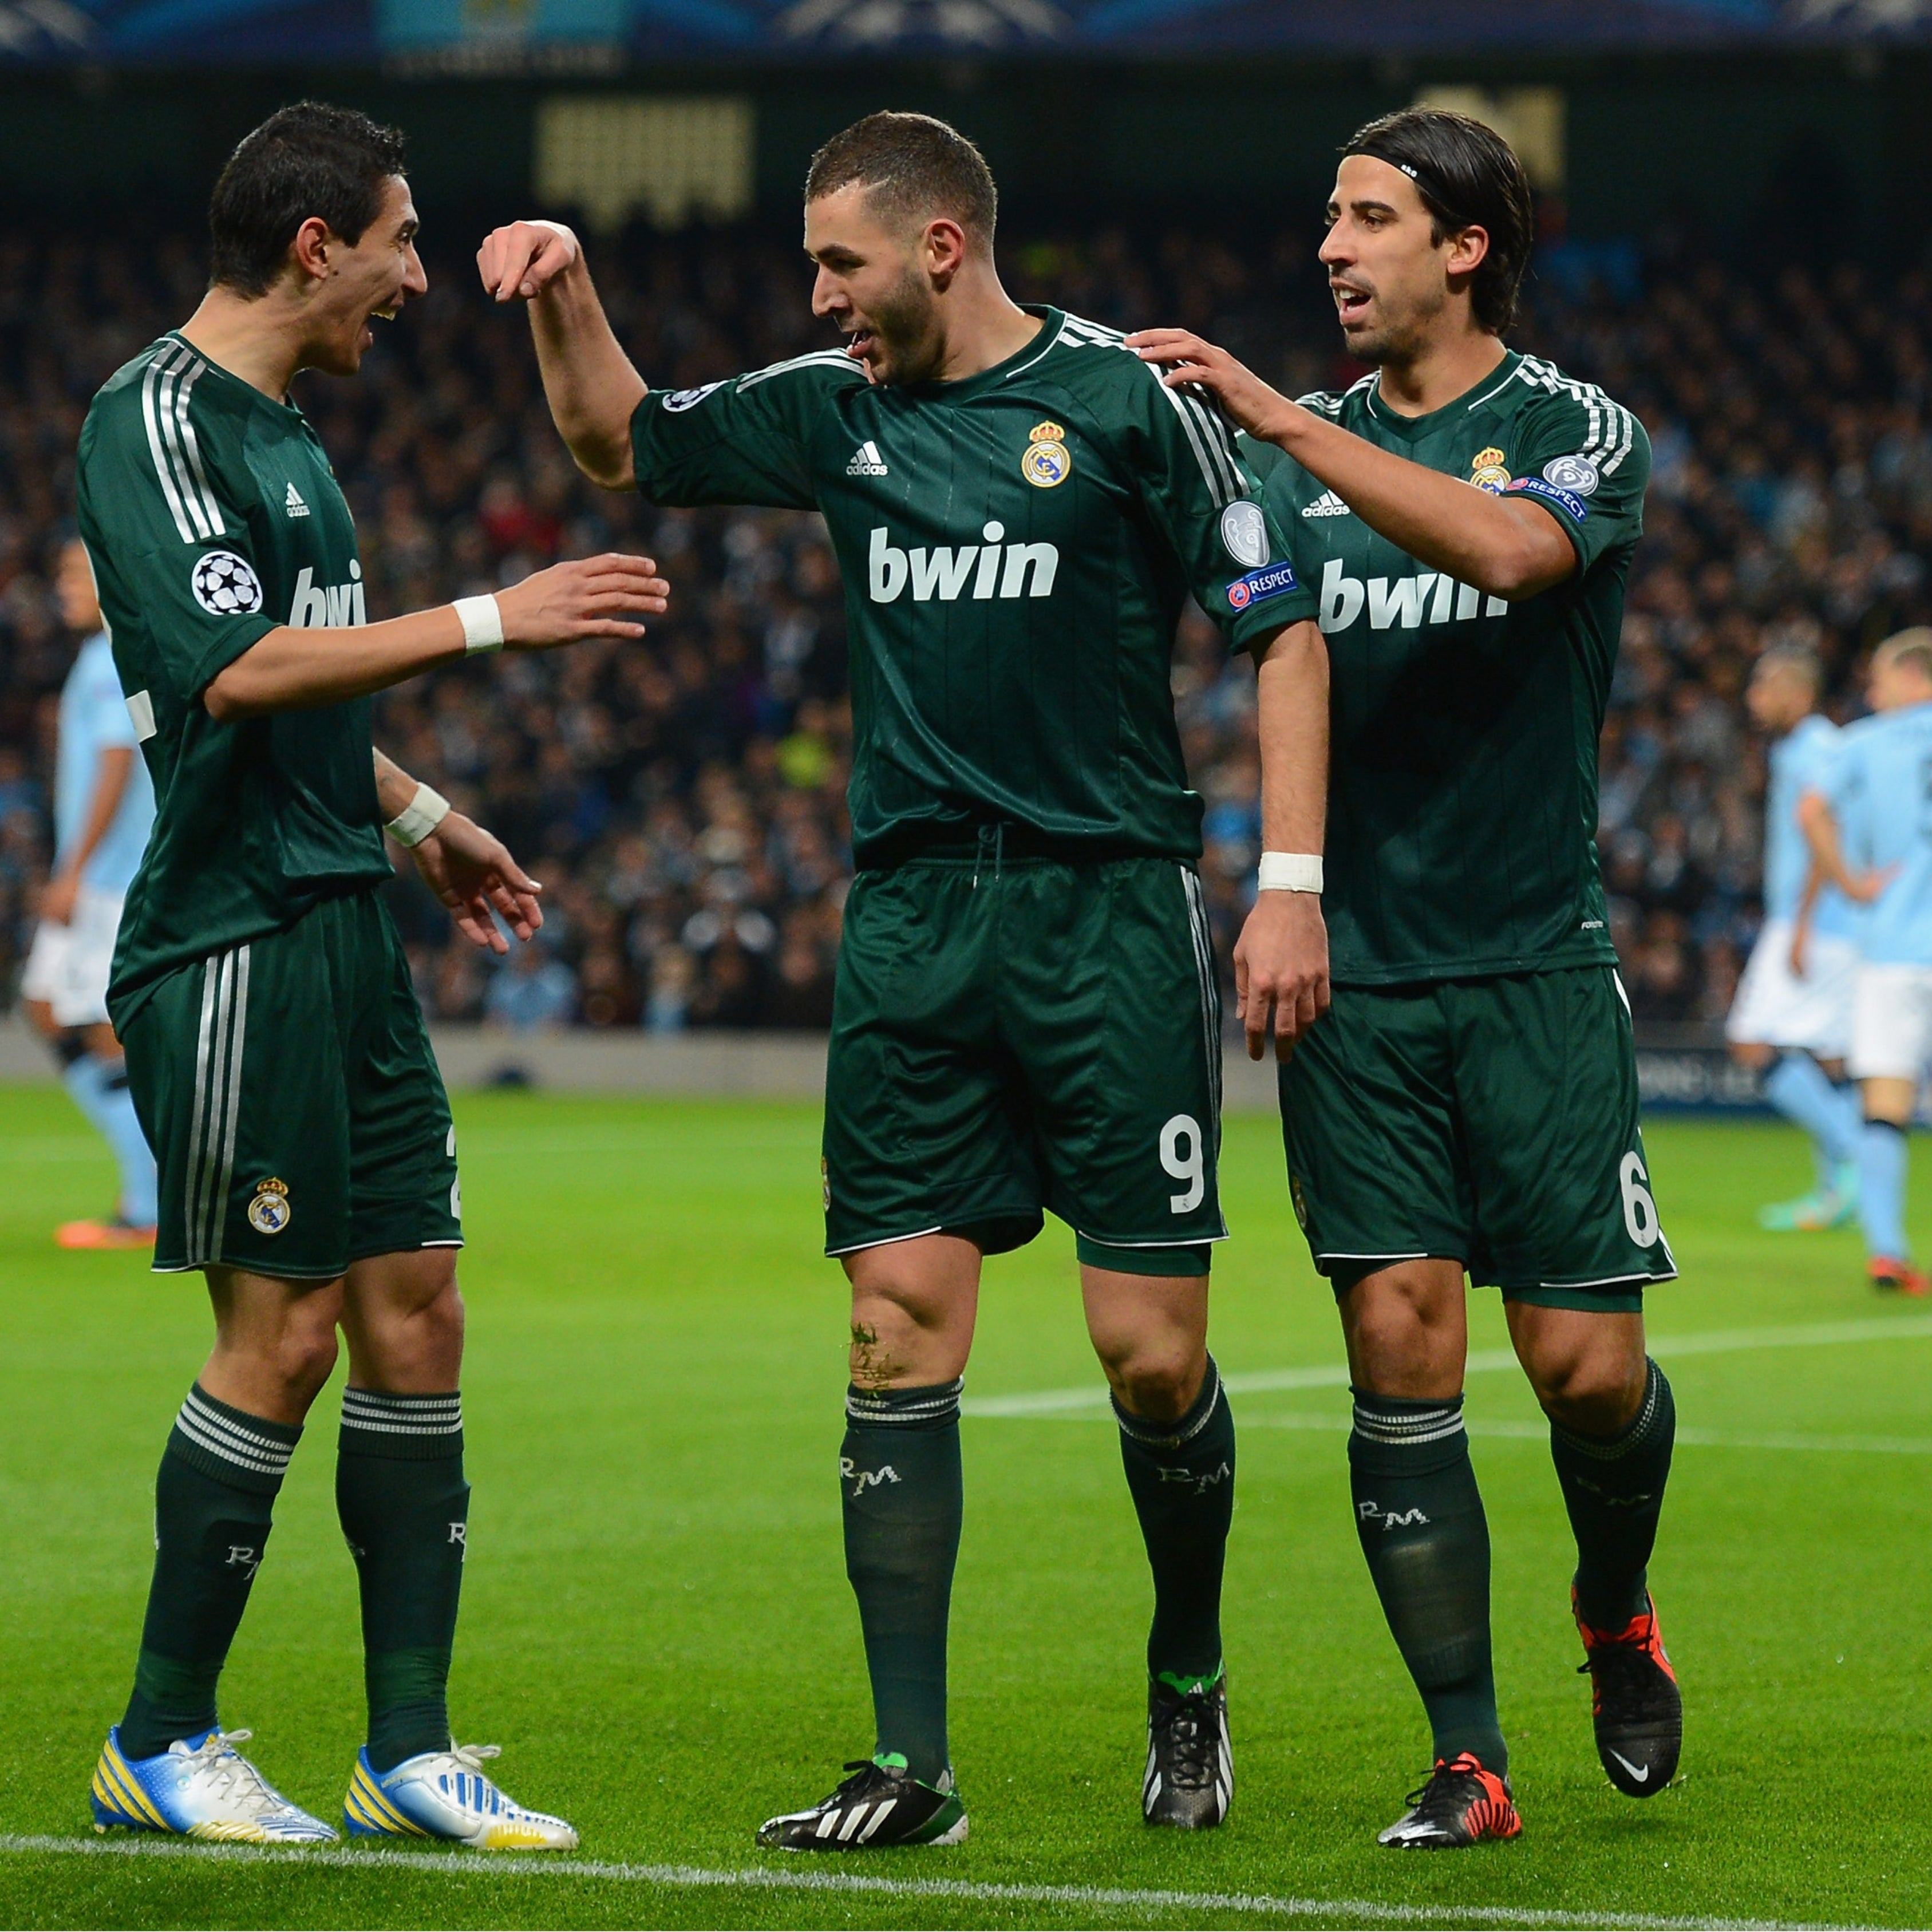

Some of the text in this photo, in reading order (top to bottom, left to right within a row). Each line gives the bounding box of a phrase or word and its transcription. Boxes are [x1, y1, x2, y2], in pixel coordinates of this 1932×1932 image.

[846, 463, 888, 476] adidas
[1302, 504, 1350, 517] adidas
[1528, 481, 1585, 517] RESPECT
[869, 520, 1059, 603] bwin
[1249, 568, 1293, 594] RESPECT
[1160, 1114, 1204, 1214] 9
[1619, 1151, 1659, 1248] 6
[840, 1456, 902, 1496] RM
[1358, 1500, 1431, 1531] RM
[447, 1522, 467, 1563] R
[224, 1546, 259, 1581] R
